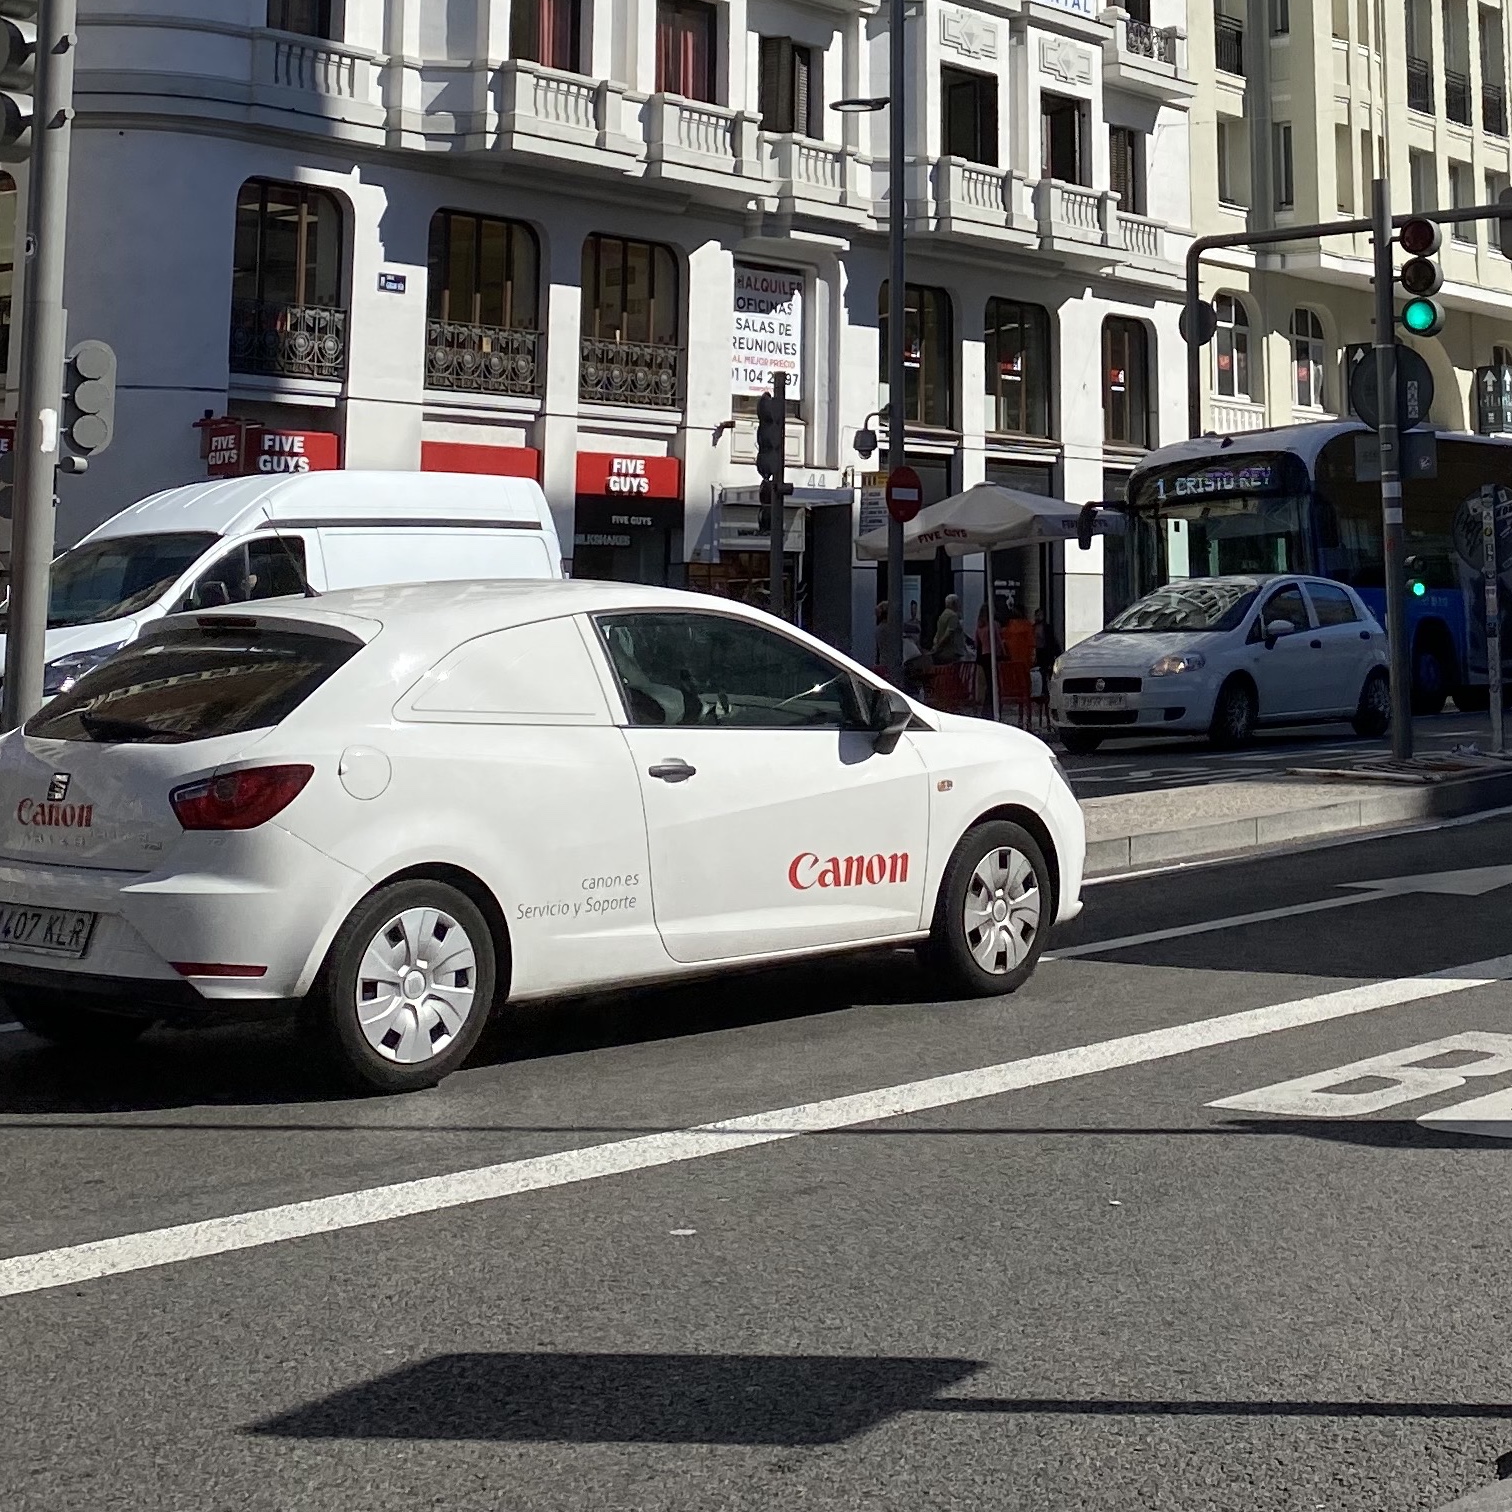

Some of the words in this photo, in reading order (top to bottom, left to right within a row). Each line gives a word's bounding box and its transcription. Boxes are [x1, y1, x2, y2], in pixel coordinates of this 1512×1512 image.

[736, 296, 793, 316] OFICINAS
[736, 318, 774, 334] SALAS
[779, 323, 792, 336] DE
[770, 359, 796, 369] PRECIO
[743, 368, 763, 383] 104
[212, 434, 236, 450] FIVE
[263, 434, 305, 454] FIVE
[208, 449, 238, 465] GUYS
[259, 454, 310, 473] GUYS
[612, 458, 646, 475] FIVE
[609, 475, 650, 493] GUYS
[807, 473, 826, 487] 44
[1156, 478, 1167, 499] 1
[1175, 471, 1235, 496] CRISTO
[1239, 466, 1271, 489] REY
[611, 515, 630, 525] FIVE
[630, 516, 652, 526] GUYS
[918, 531, 941, 543] FIVE
[17, 798, 94, 828] Canon
[788, 852, 909, 890] Canon
[581, 873, 639, 890] canon.es
[517, 900, 570, 920] Servicio
[573, 903, 581, 919] y
[585, 895, 637, 915] Soporte
[44, 914, 85, 947] KLR
